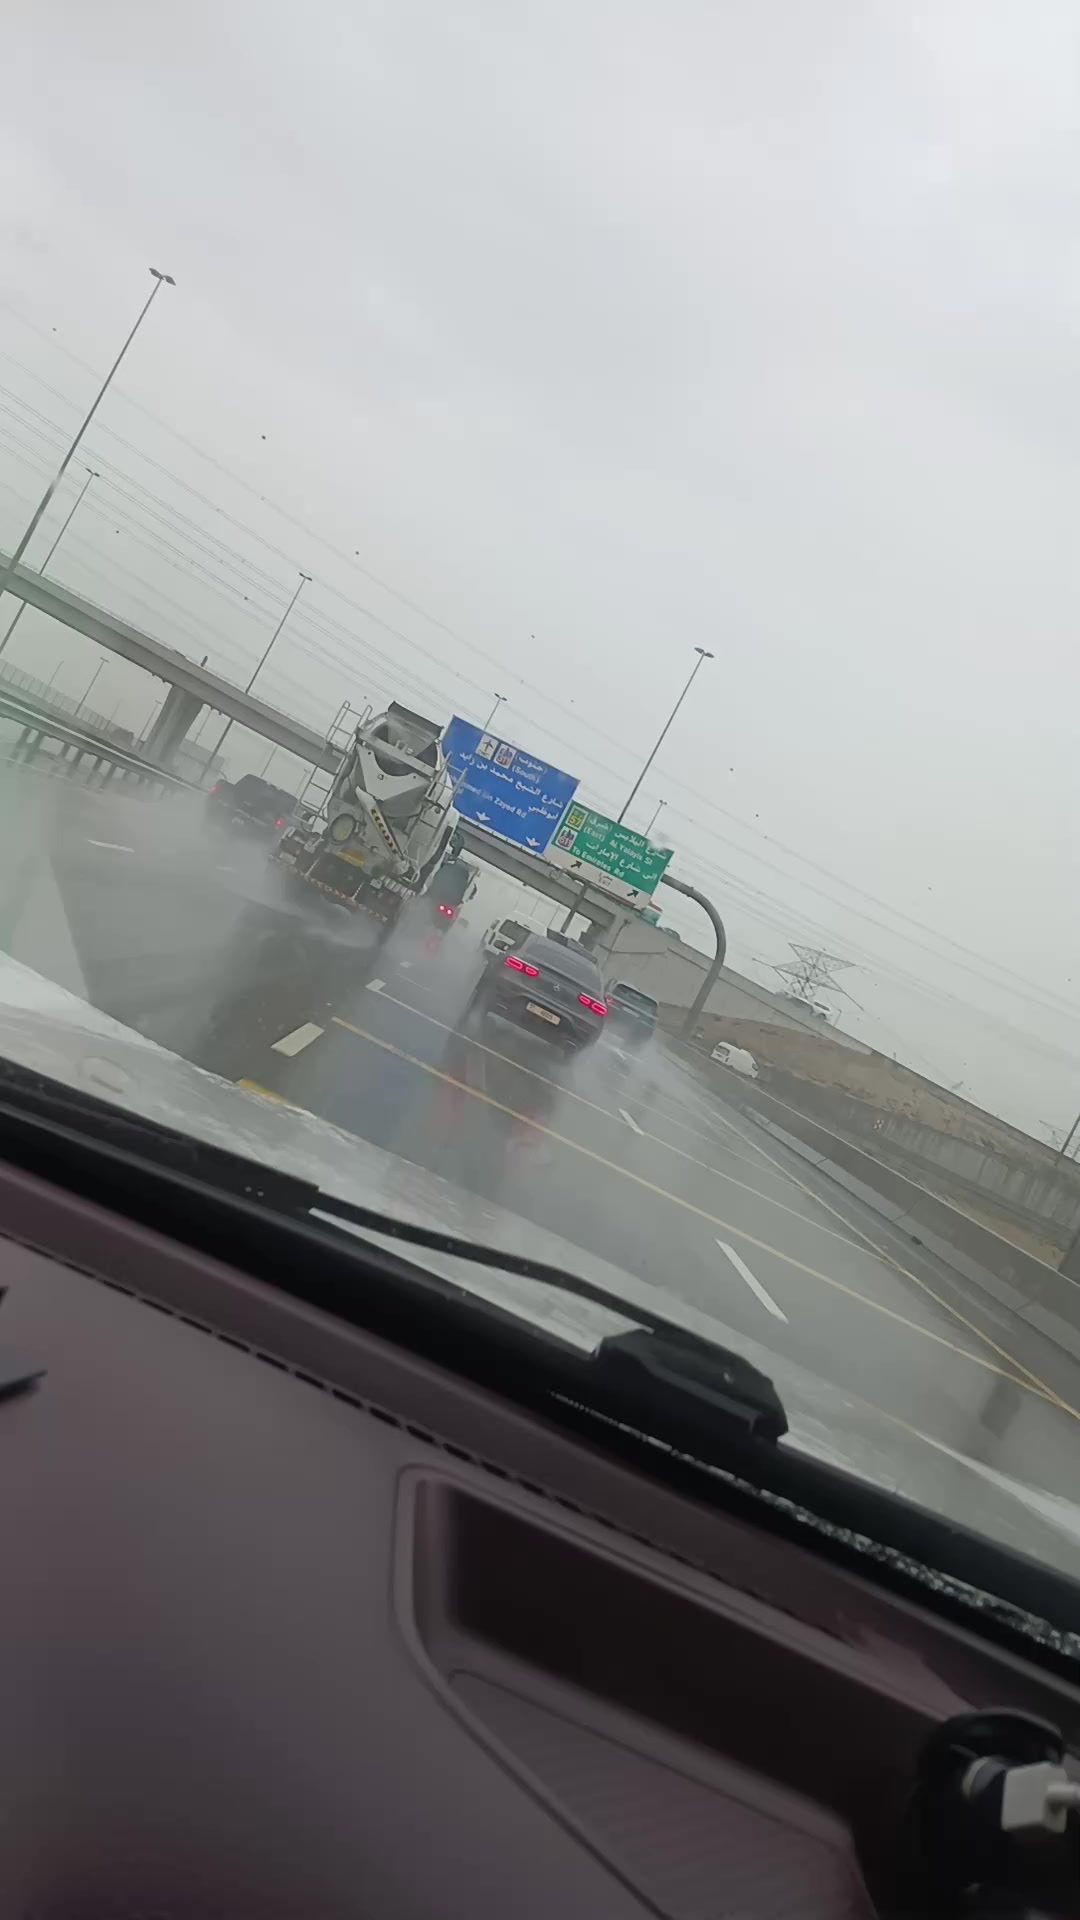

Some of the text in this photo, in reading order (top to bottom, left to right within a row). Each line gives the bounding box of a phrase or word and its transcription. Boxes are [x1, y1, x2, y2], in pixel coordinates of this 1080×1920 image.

[459, 752, 475, 765] زايد
[476, 761, 488, 770] بن
[489, 767, 514, 783] محمد
[511, 764, 541, 784] (South)
[515, 781, 541, 797] الشيخ
[493, 796, 517, 814] Zayed
[515, 807, 527, 819] Rd
[541, 793, 563, 809] شارع
[568, 815, 582, 827] 57
[583, 826, 606, 842] (East)
[643, 856, 653, 866] St
[572, 846, 581, 855] To
[581, 852, 612, 872] Emirates
[613, 867, 625, 878] Rd
[619, 858, 641, 873] شارع
